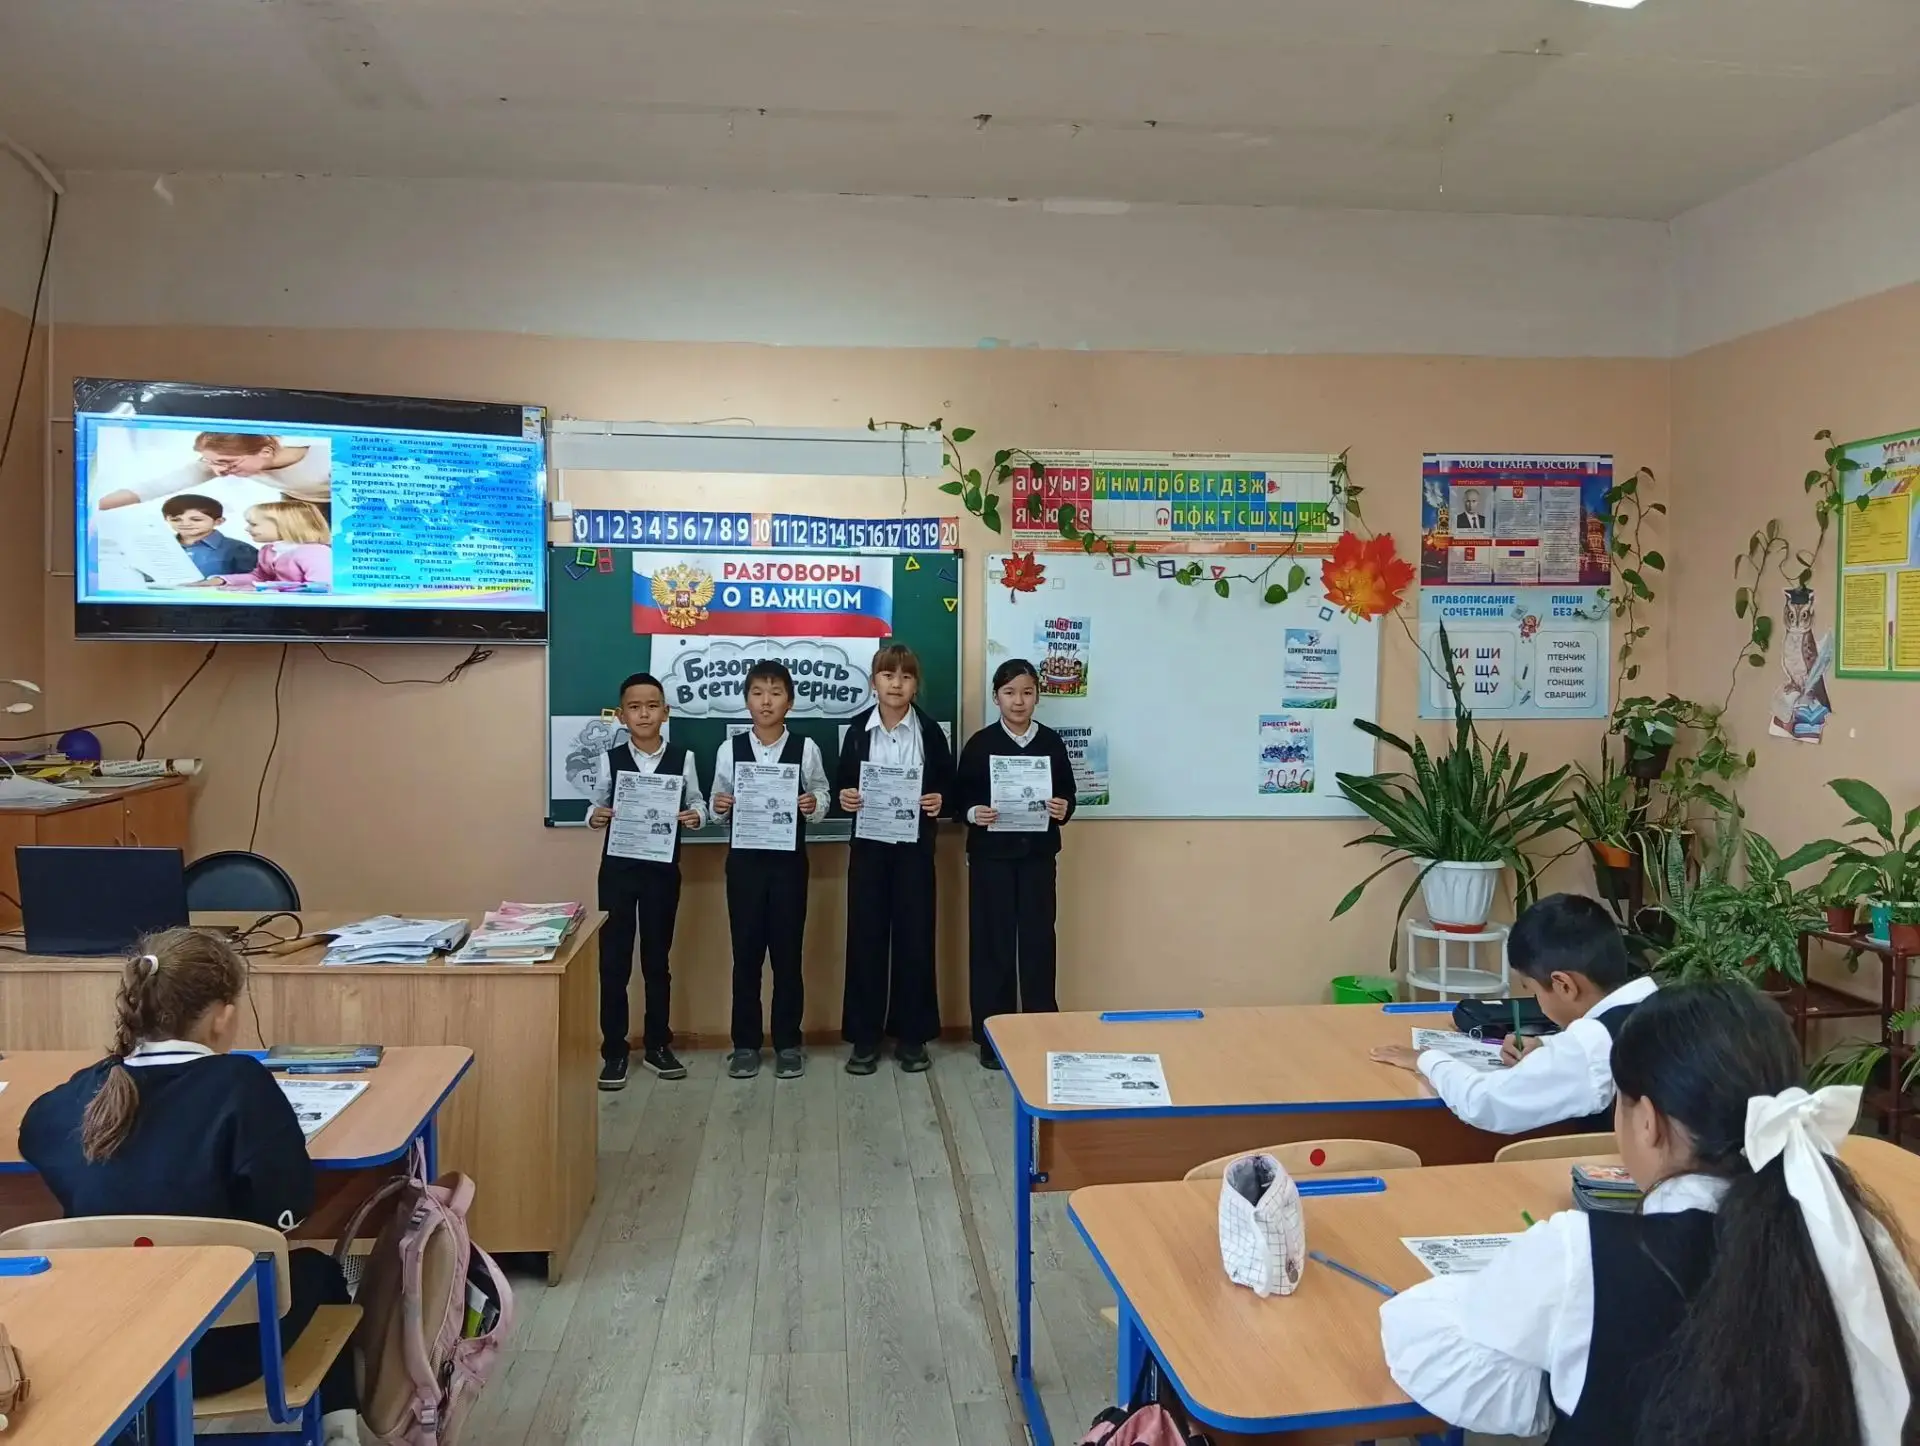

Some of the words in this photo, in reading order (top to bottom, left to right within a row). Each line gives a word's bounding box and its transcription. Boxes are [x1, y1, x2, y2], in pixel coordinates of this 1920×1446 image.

[1458, 460, 1485, 470] МОЯ
[1488, 460, 1533, 470] СТРАНА
[1536, 461, 1581, 470] РОССИЯ
[1015, 475, 1026, 491] а
[1048, 475, 1059, 497] у
[1062, 475, 1076, 491] ы
[1080, 476, 1090, 491] э
[1095, 471, 1106, 492] й
[1111, 478, 1121, 492] н
[1125, 477, 1139, 492] м
[1142, 477, 1153, 492] л
[1158, 477, 1169, 498] р
[1174, 473, 1184, 493] б
[1189, 478, 1200, 492] в
[1206, 478, 1215, 492] г
[1220, 478, 1233, 497] д
[1238, 478, 1247, 493] з
[1251, 478, 1264, 493] ж
[1329, 480, 1342, 494] ъ
[1016, 508, 1026, 523] я
[1046, 507, 1059, 523] ю
[1080, 508, 1090, 523] е
[1174, 510, 1184, 524] п
[1188, 506, 1200, 530] ф
[1205, 510, 1215, 524] к
[1221, 510, 1231, 524] т
[1238, 510, 1246, 525] с
[1251, 510, 1265, 525] ш
[1268, 511, 1278, 525] х
[1283, 511, 1294, 529] ц
[1300, 511, 1309, 525] ч
[1313, 511, 1326, 529] щ
[1329, 511, 1340, 526] ь
[575, 514, 589, 541] 0
[596, 515, 605, 539] 1
[612, 515, 625, 539] 2
[631, 516, 643, 540] 3
[649, 516, 661, 540] 4
[666, 517, 678, 540] 5
[683, 517, 697, 541] 6
[702, 518, 714, 541] 7
[720, 517, 732, 541] 8
[737, 518, 749, 541] 9
[752, 518, 770, 542] 10
[773, 519, 788, 543] 11
[791, 520, 808, 544] 12
[811, 521, 827, 545] 13
[829, 522, 846, 546] 14
[848, 523, 865, 547] 15
[868, 523, 884, 547] 16
[886, 523, 902, 547] 17
[904, 522, 920, 546] 18
[922, 522, 939, 546] 19
[941, 522, 957, 546] 20
[722, 562, 861, 582] РАЗГОВОРЫ
[722, 586, 741, 607] О
[750, 587, 862, 610] ВАЖНОМ
[1431, 595, 1515, 605] ПРАВОПИСАНИЕ
[1551, 595, 1583, 604] ПИШИ
[1442, 605, 1504, 616] СОЧЕТАНИЙ
[1553, 607, 1572, 616] БЕЗ
[1046, 631, 1080, 640] НАРОДОВ
[1048, 641, 1077, 650] РОССИИ
[1476, 647, 1501, 659] ШИ
[1547, 653, 1586, 661] ПТЕНЧИК
[683, 657, 849, 684] Безопность
[1475, 664, 1500, 677] ЩА
[1475, 681, 1499, 694] ЩУ
[1547, 679, 1584, 687] ГОНЩИК
[676, 683, 694, 704] в
[701, 680, 746, 701] сети
[792, 680, 864, 704] тернет
[1544, 691, 1587, 699] СВАРЩИК
[1057, 728, 1092, 737] ДИНСТВО
[1063, 739, 1089, 748] РОДОВ
[1263, 768, 1310, 790] 2026
